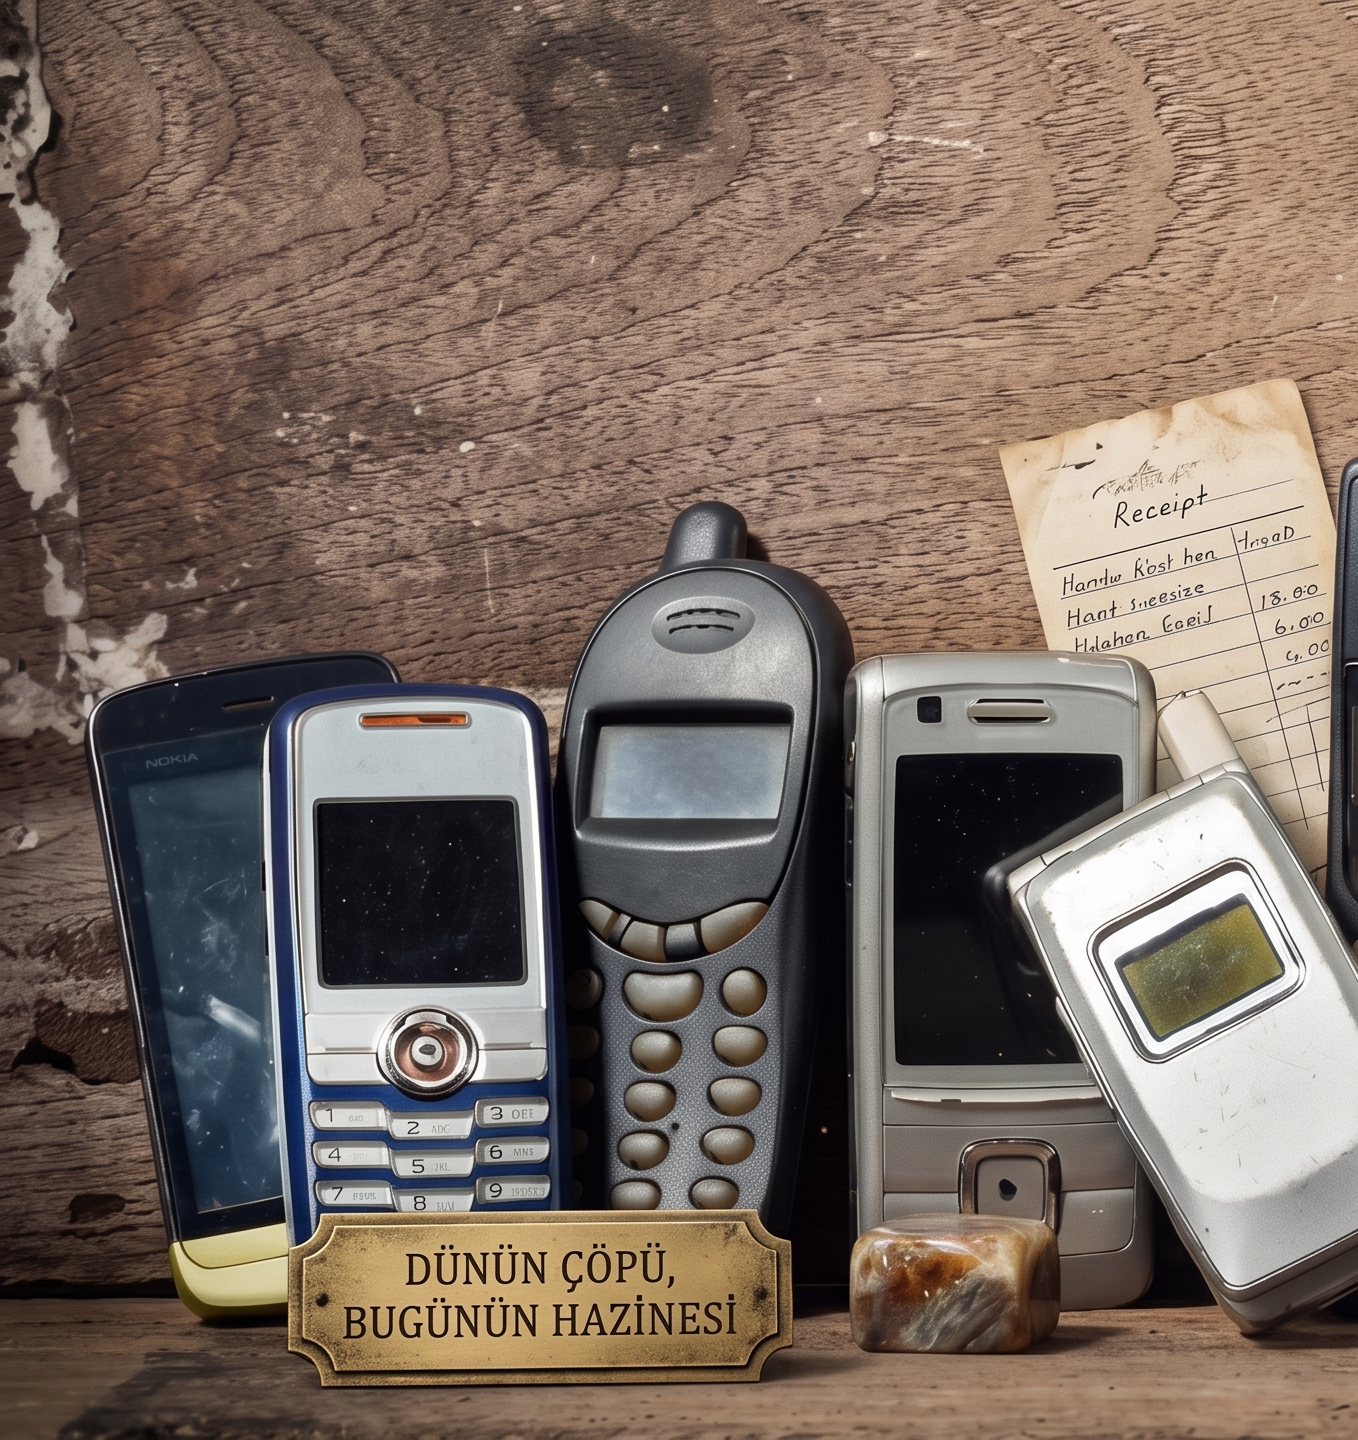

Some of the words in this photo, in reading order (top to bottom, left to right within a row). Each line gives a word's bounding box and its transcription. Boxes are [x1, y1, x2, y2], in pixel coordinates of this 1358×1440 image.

[1113, 483, 1209, 529] Receipt
[145, 753, 199, 769] NOKIA
[325, 1108, 334, 1123] 1
[489, 1106, 504, 1120] 3
[406, 1121, 420, 1135] 2
[328, 1147, 342, 1162] 4
[488, 1144, 503, 1160] 6
[411, 1159, 425, 1174] 5
[330, 1186, 344, 1202] 7
[488, 1182, 503, 1198] 9
[412, 1195, 427, 1211] 8
[405, 1243, 548, 1287] DÜNÜN
[561, 1243, 675, 1293] ÇÖPÜ,
[342, 1297, 539, 1340] BUGÜNÜN
[552, 1293, 738, 1337] HAZİNESİ
